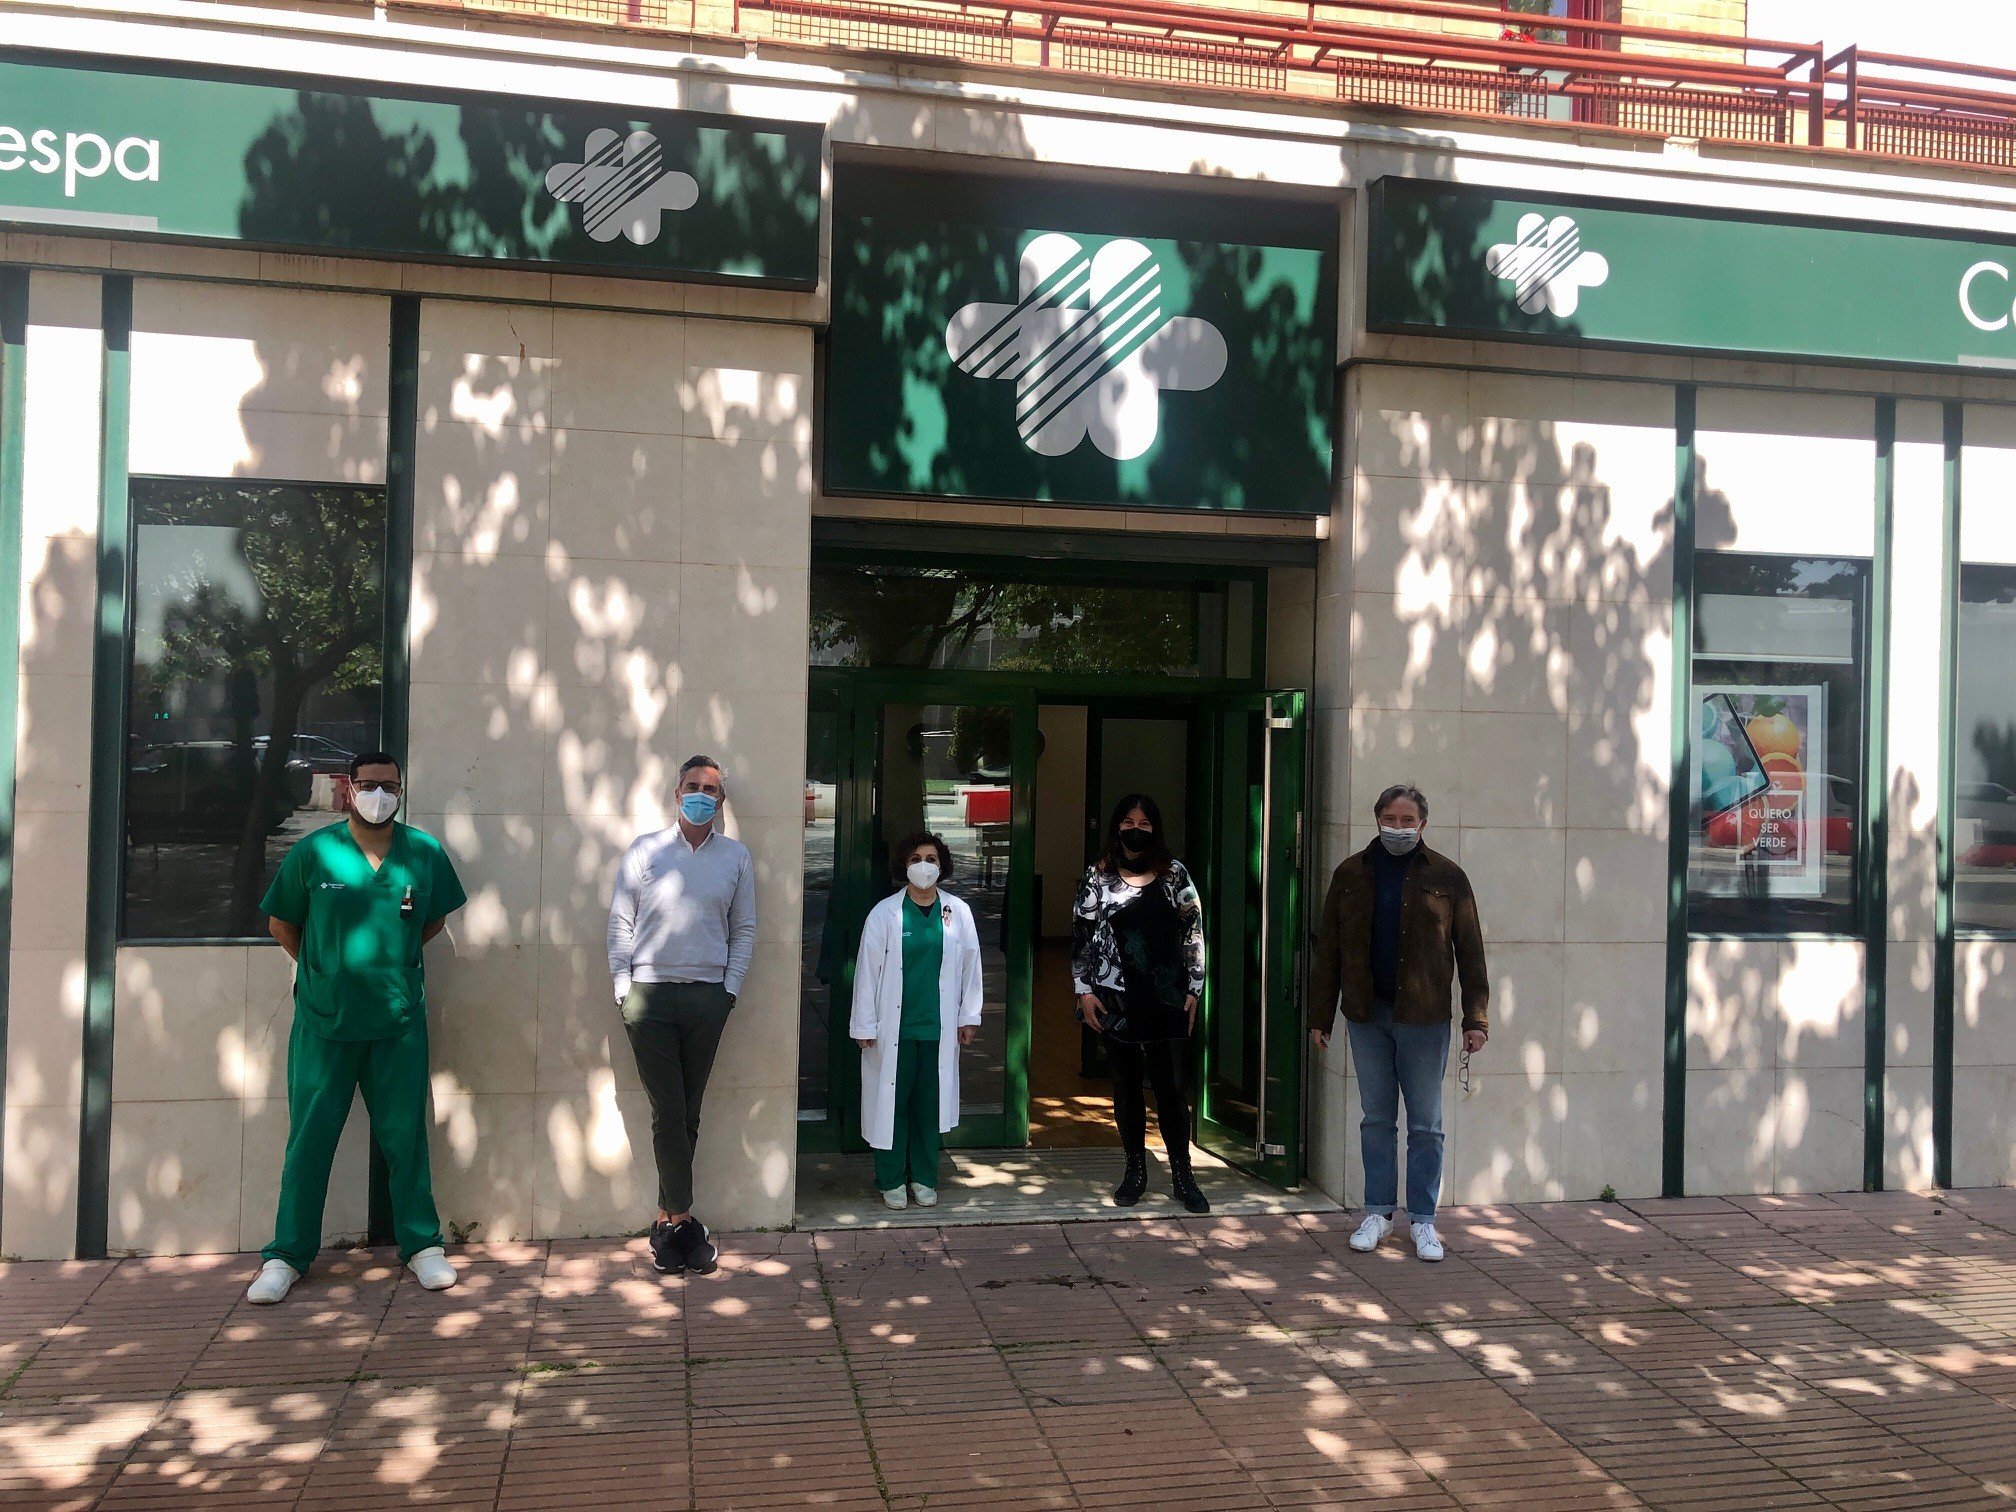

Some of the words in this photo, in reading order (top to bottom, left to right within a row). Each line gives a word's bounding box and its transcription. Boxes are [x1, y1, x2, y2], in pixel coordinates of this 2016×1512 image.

[1959, 260, 2016, 331] C
[1748, 808, 1792, 819] QUIERO
[1760, 822, 1779, 834] SER
[1752, 837, 1787, 848] VERDE
